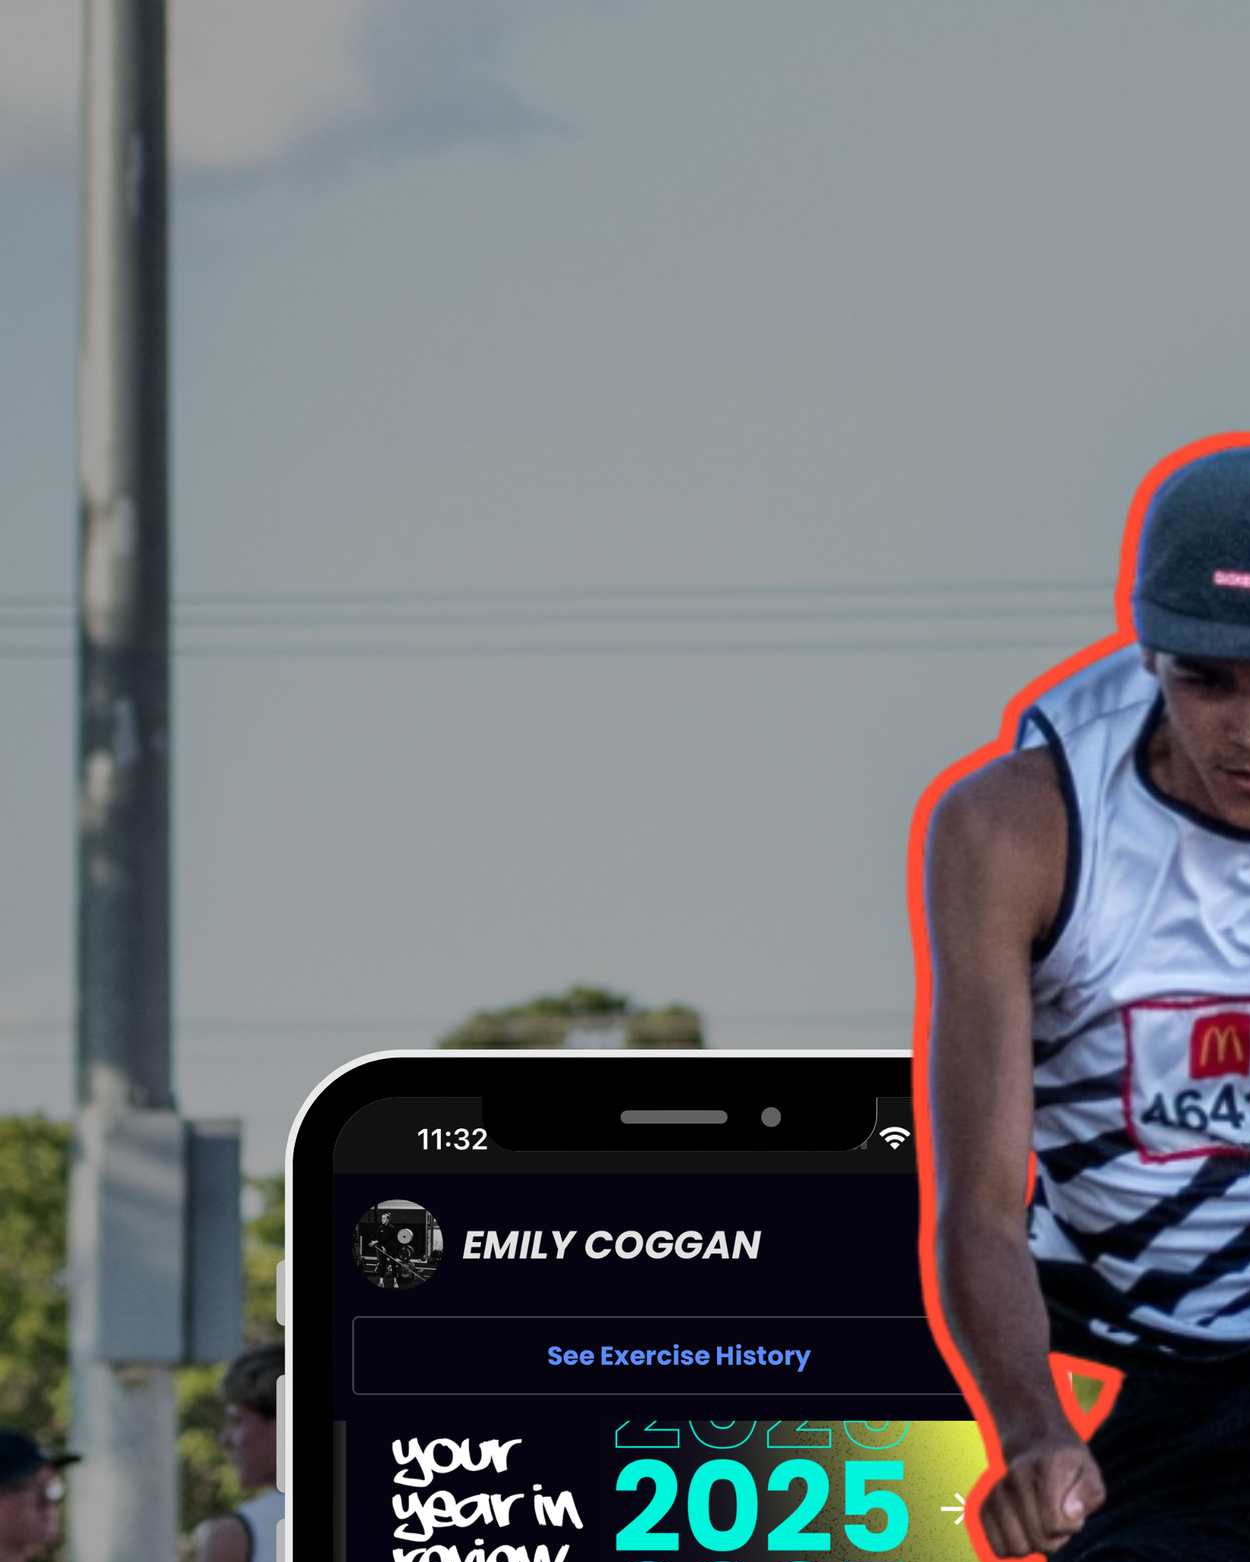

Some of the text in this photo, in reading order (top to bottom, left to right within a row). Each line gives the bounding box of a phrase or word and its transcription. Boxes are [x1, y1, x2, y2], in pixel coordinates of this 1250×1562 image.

[417, 1127, 488, 1151] 11:32
[462, 1230, 762, 1260] EMILY COGGAN
[547, 1343, 812, 1373] See Exercise History
[392, 1437, 523, 1488] your
[392, 1483, 584, 1543] year in
[615, 1458, 910, 1553] 2025
